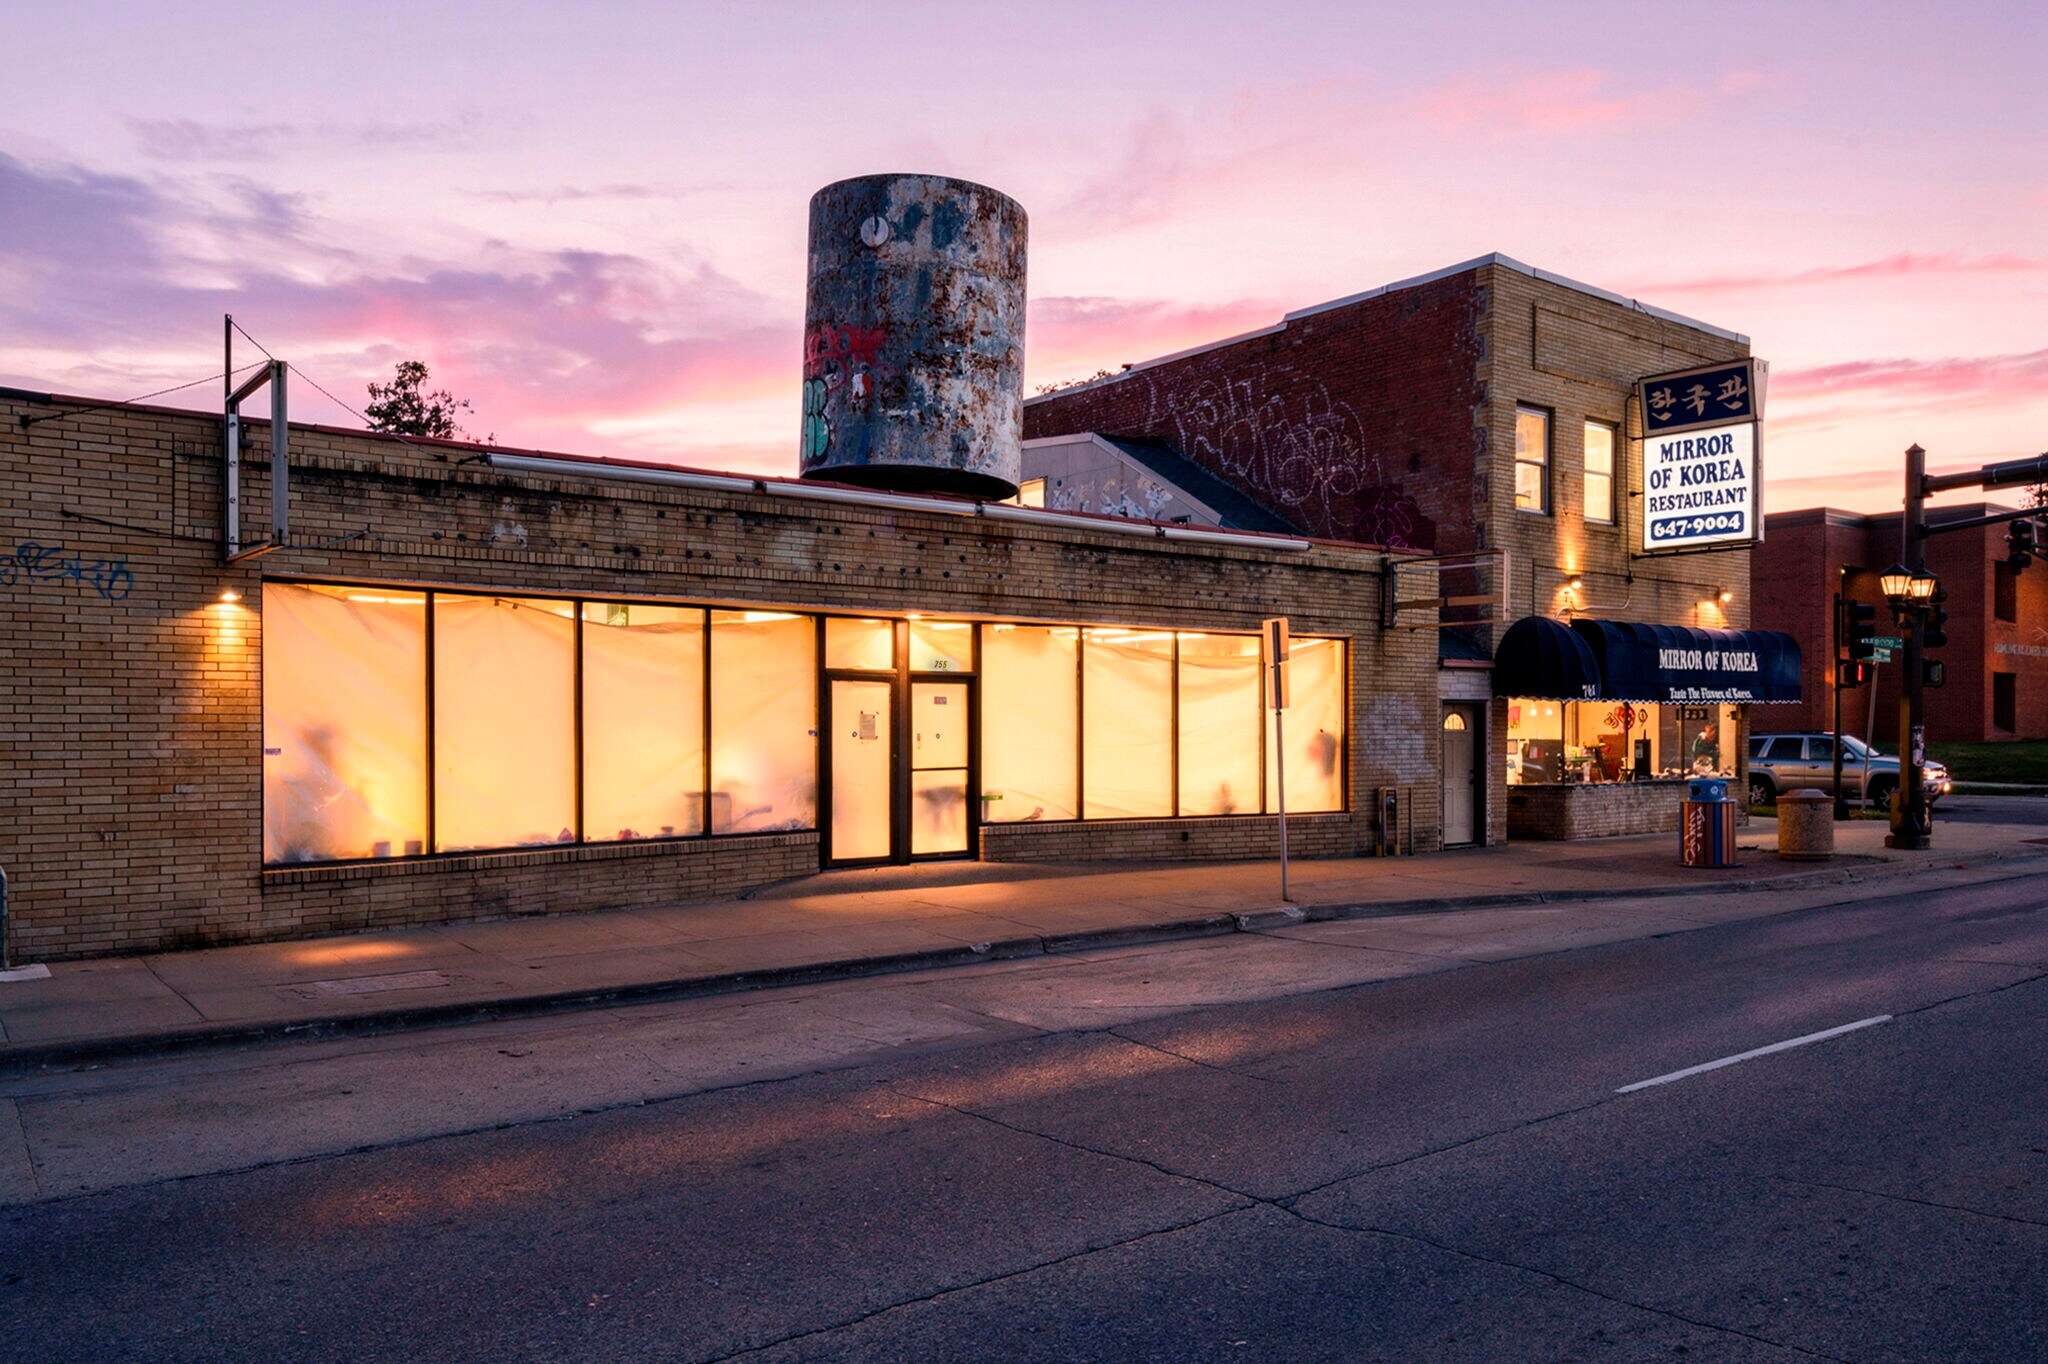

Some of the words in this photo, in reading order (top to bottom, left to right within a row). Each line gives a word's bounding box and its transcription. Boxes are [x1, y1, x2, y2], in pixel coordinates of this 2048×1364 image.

[1648, 375, 1748, 421] 한국관
[1660, 433, 1734, 463] MIRROR
[1650, 468, 1672, 489] OF
[1680, 459, 1745, 486] KOREA
[1649, 486, 1747, 513] RESTAURANT
[934, 660, 947, 668] 755
[1659, 649, 1703, 670] MIRROR
[1705, 650, 1719, 671] OF
[1721, 651, 1758, 672] KOREA
[1687, 687, 1700, 699] The
